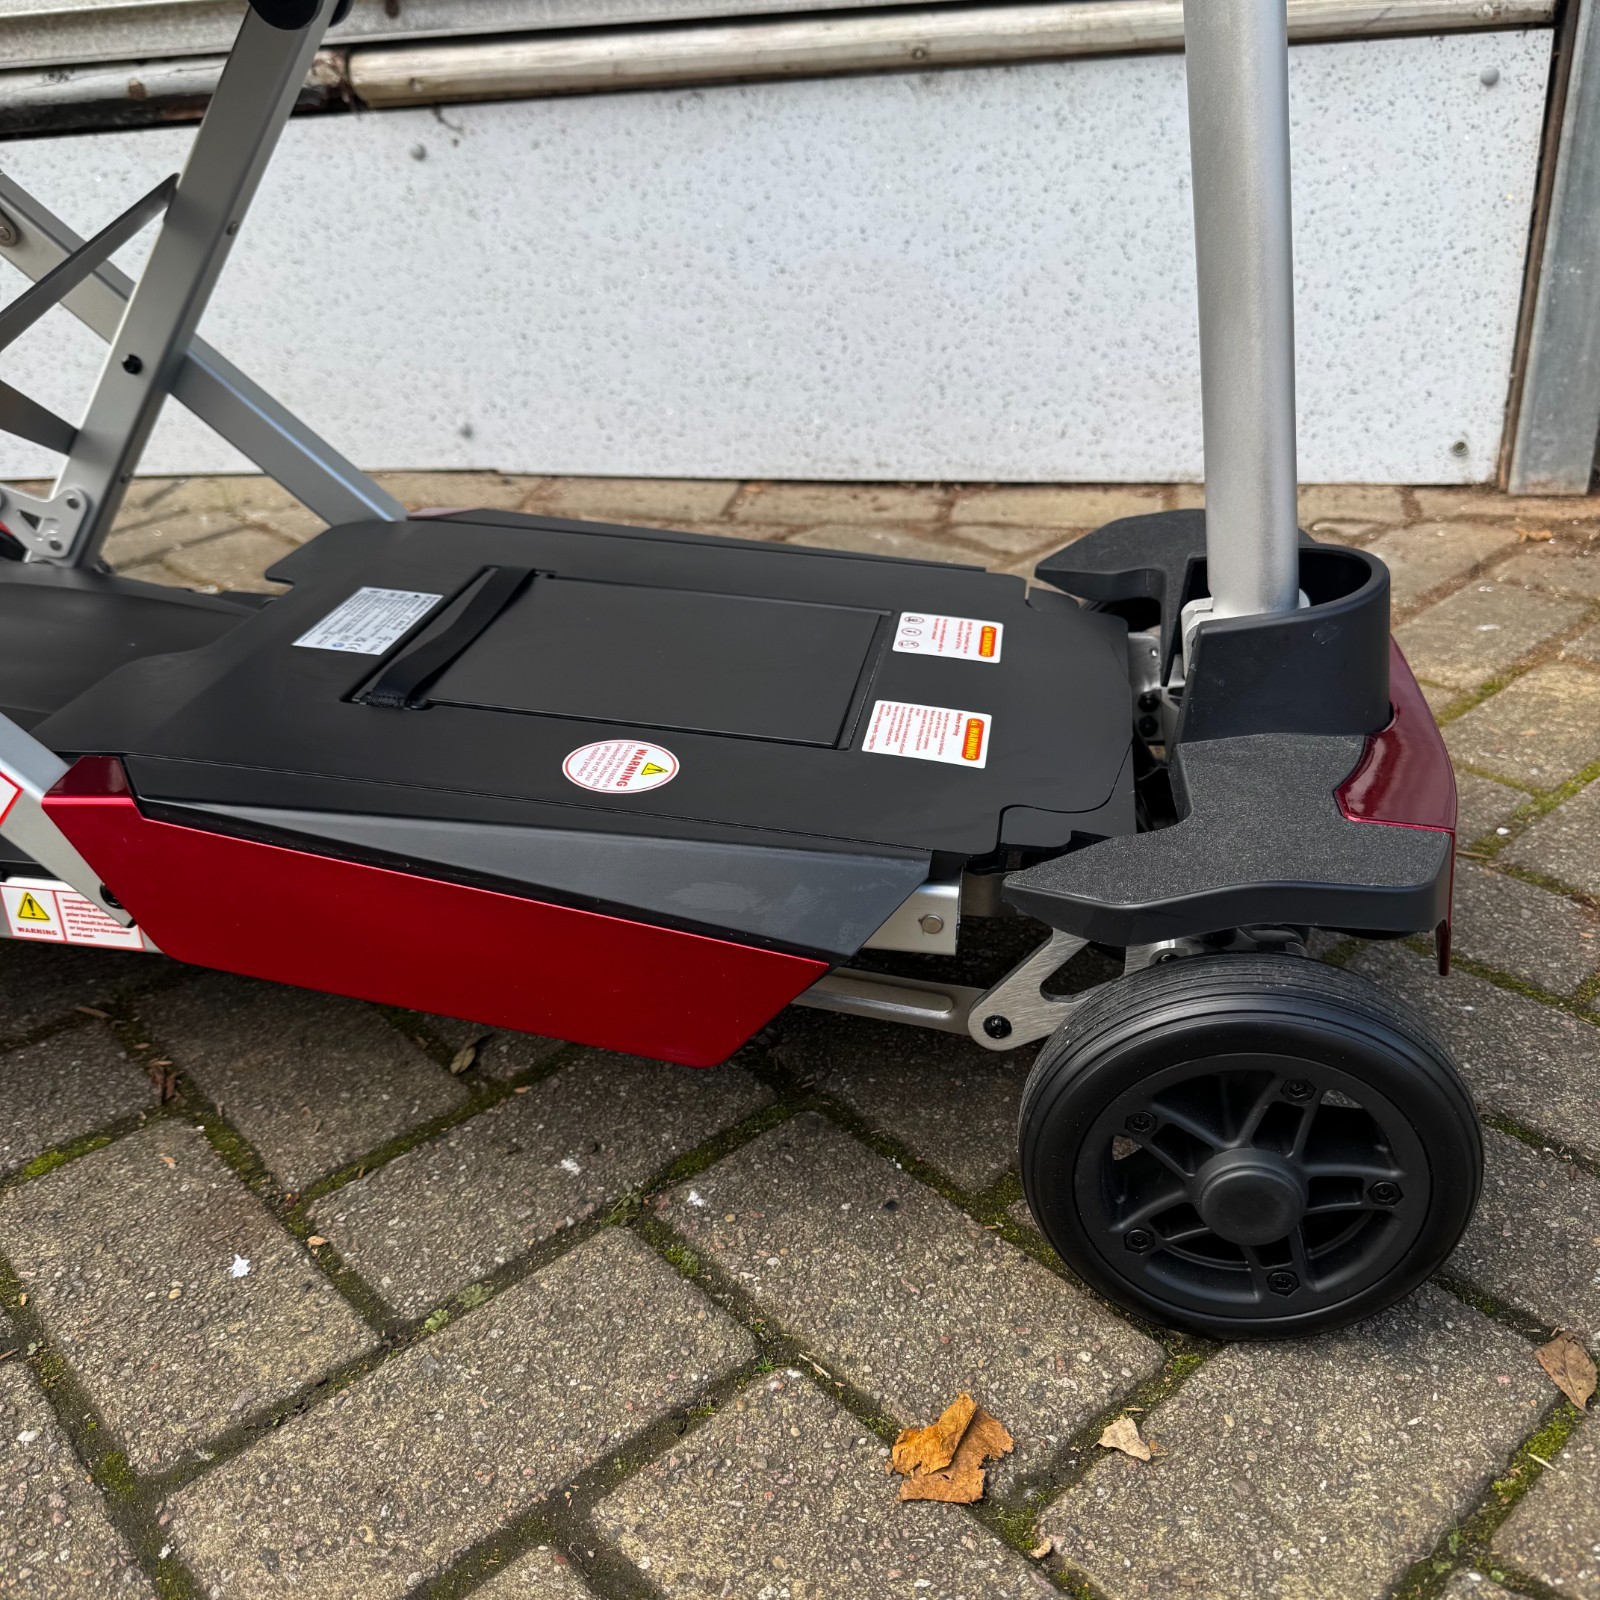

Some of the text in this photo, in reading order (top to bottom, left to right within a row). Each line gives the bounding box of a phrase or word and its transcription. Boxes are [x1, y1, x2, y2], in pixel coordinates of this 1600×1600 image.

[966, 728, 979, 759] WARNING
[616, 749, 648, 786] WARNING
[17, 926, 58, 936] WARNING
